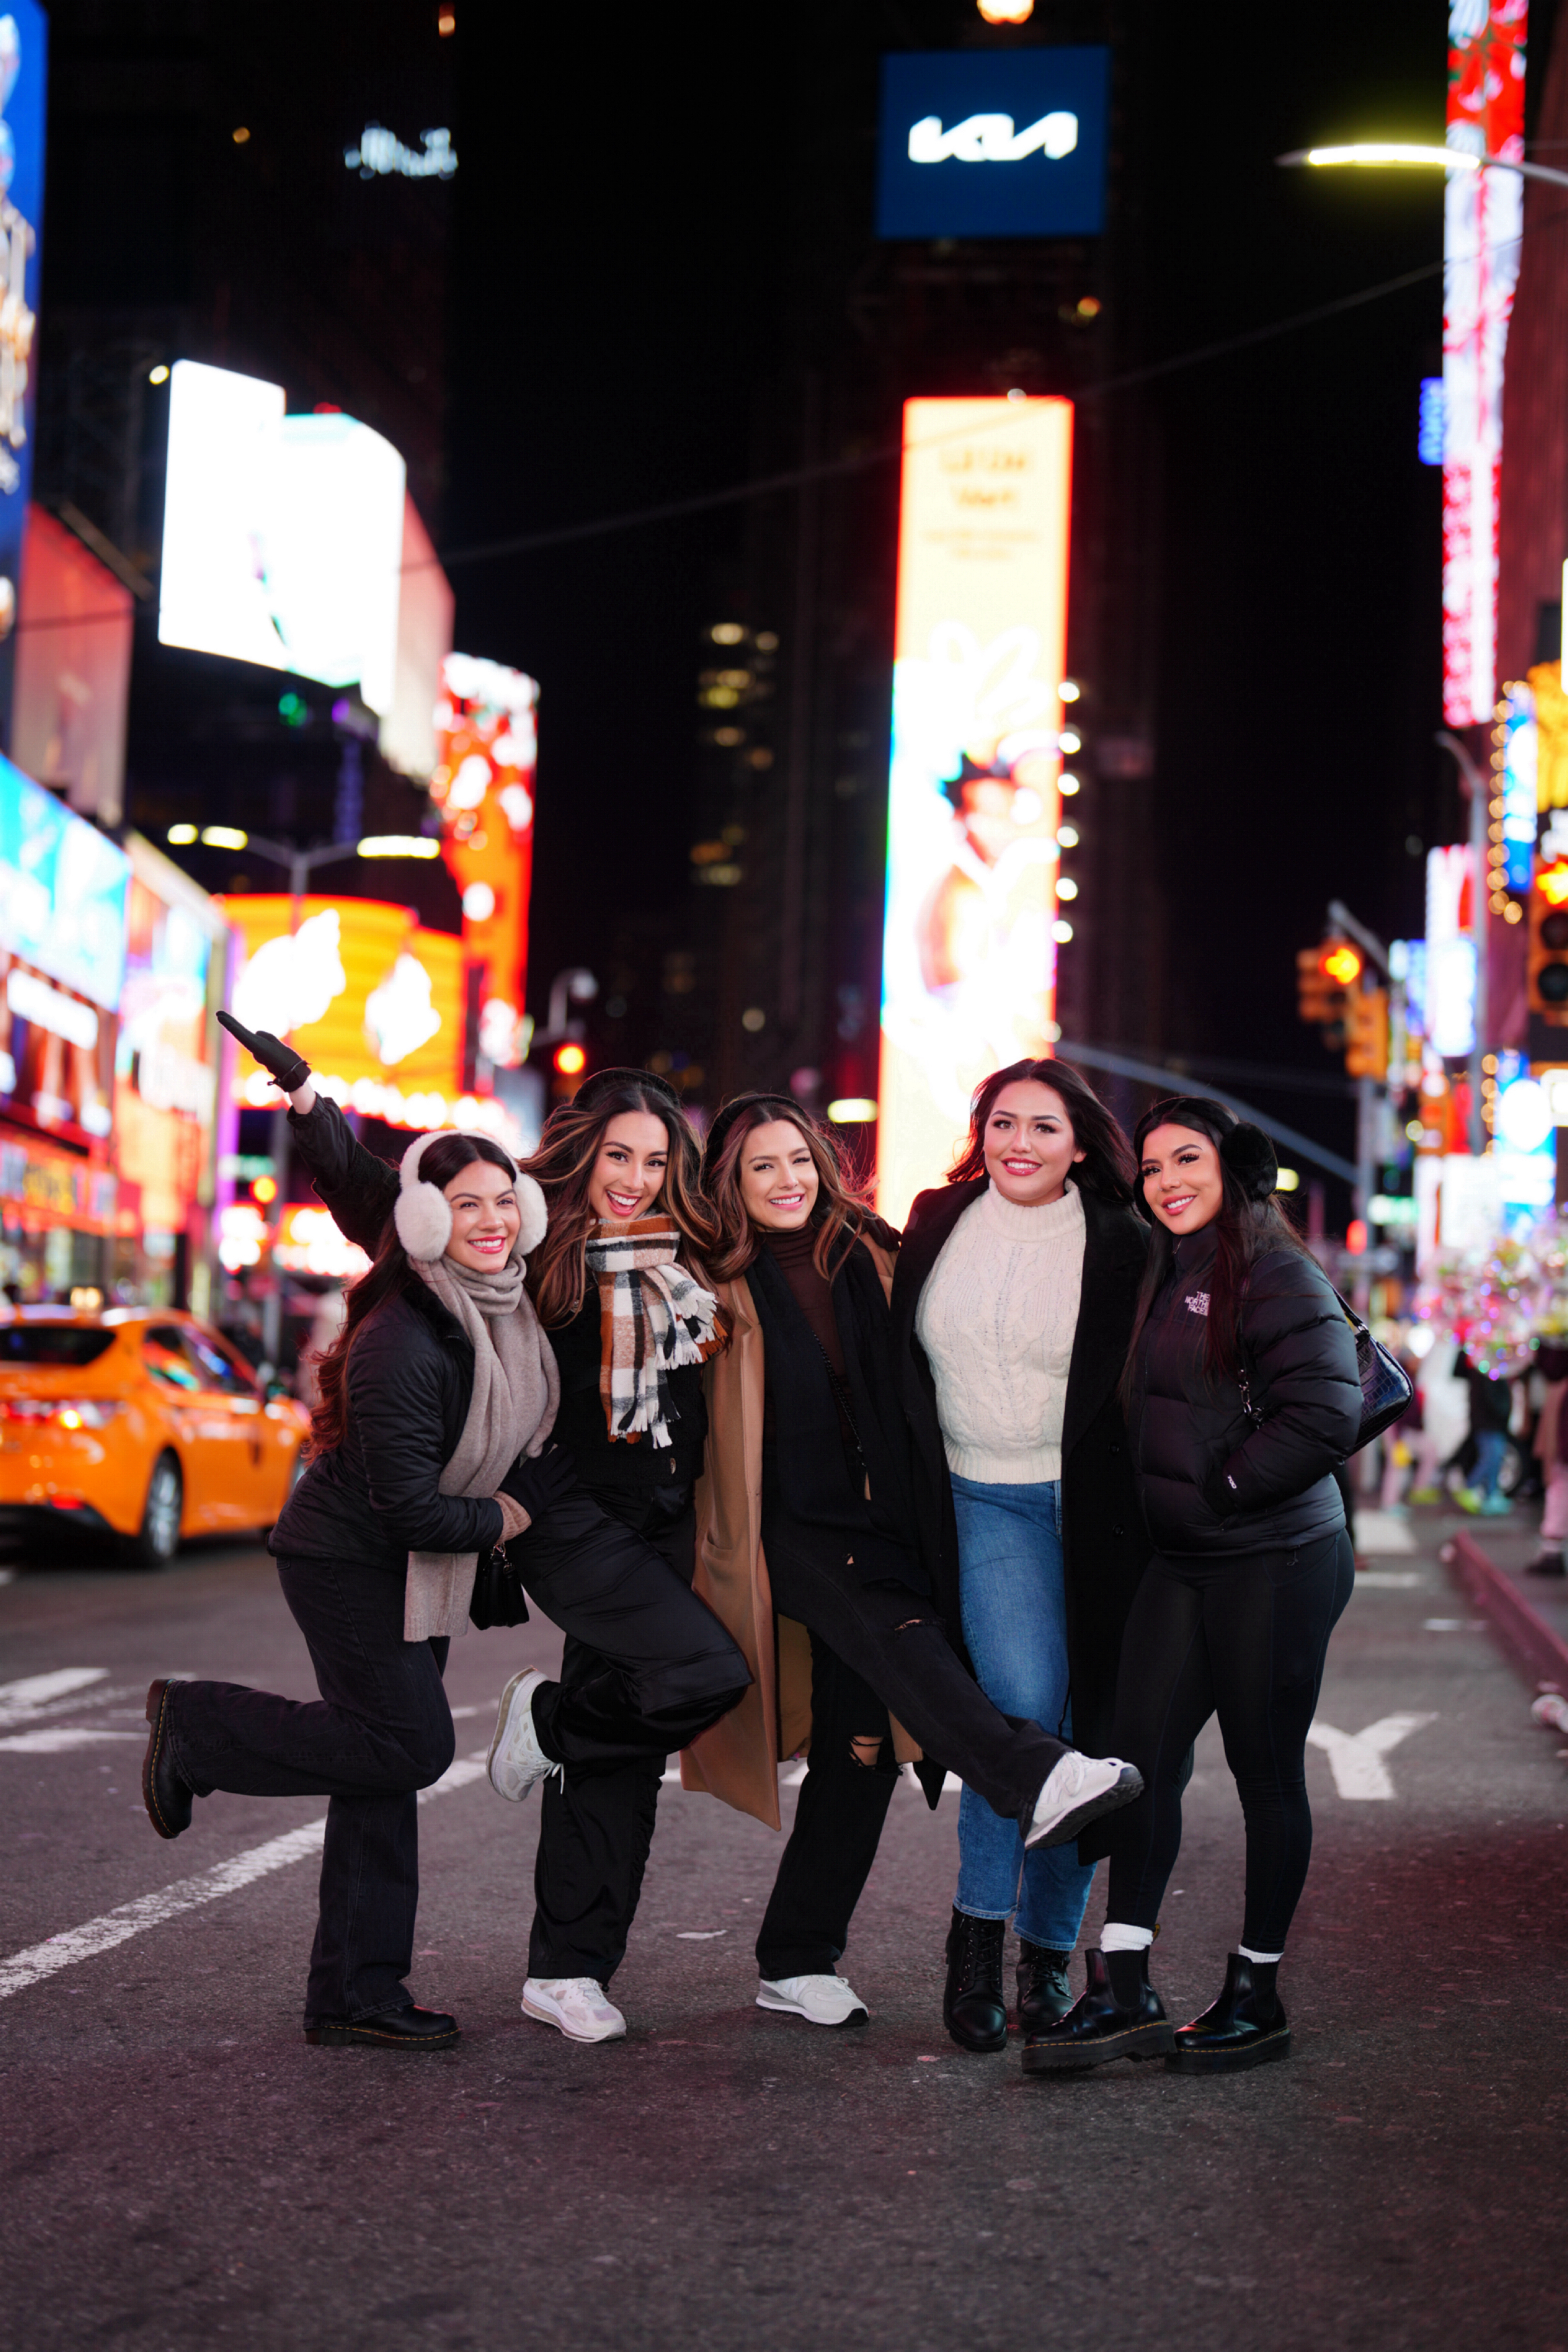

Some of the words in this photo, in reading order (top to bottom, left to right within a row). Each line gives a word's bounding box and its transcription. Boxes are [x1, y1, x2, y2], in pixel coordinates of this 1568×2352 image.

[1196, 1291, 1210, 1300] THE
[1185, 1296, 1208, 1308] NORTH
[1188, 1304, 1206, 1314] FACE
